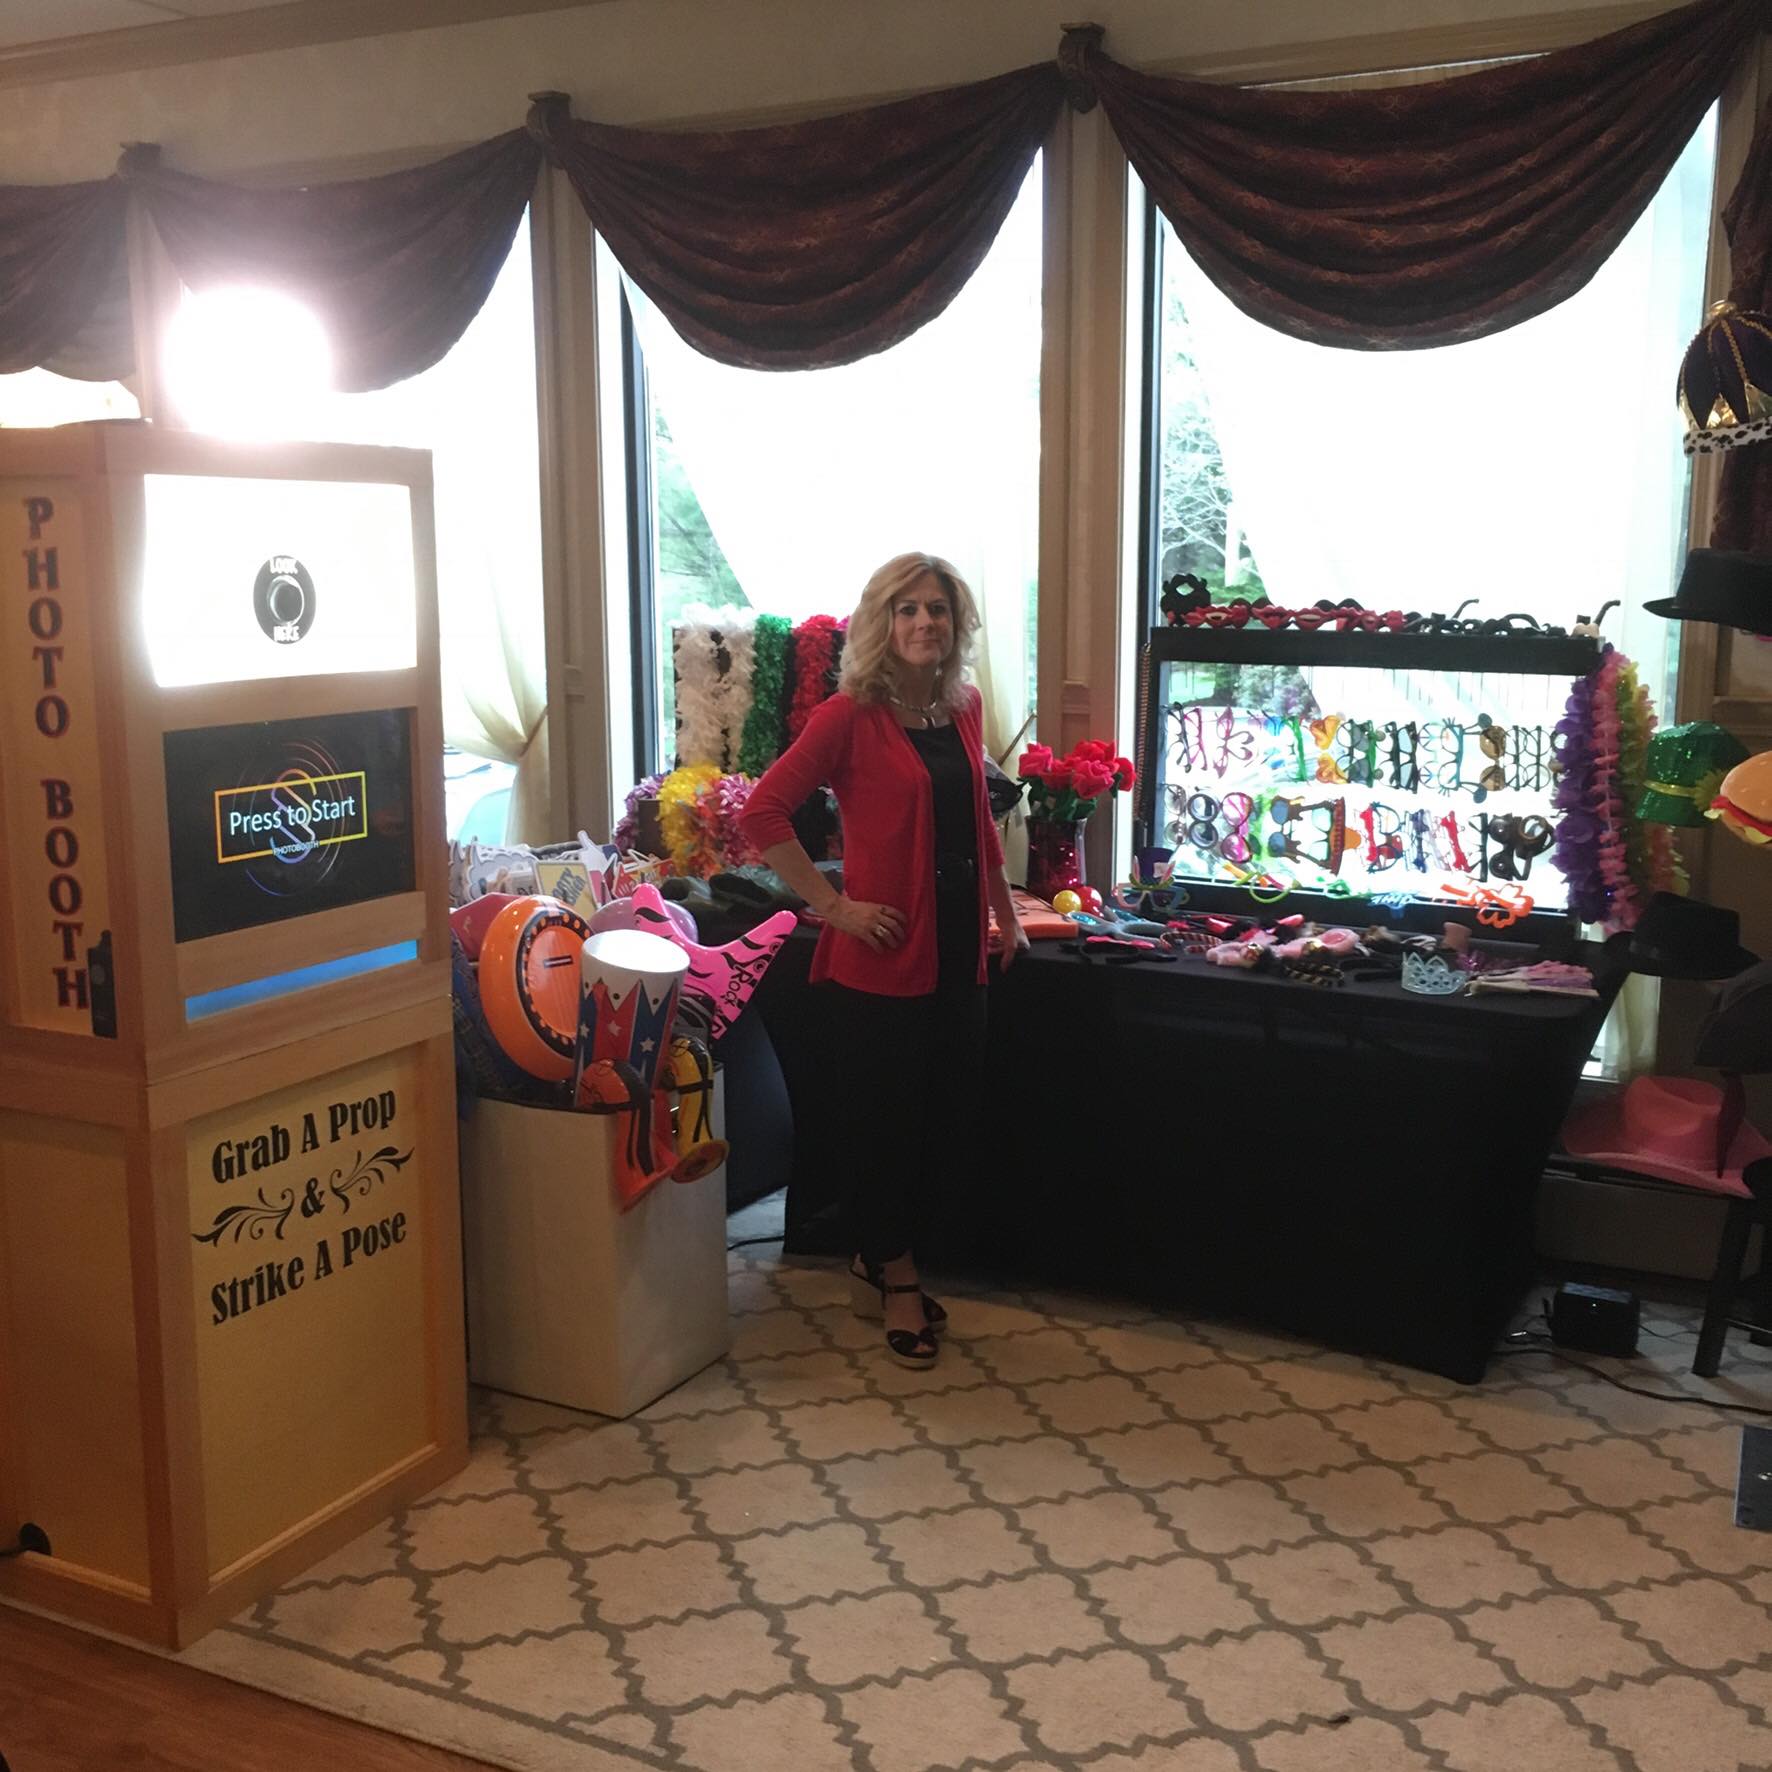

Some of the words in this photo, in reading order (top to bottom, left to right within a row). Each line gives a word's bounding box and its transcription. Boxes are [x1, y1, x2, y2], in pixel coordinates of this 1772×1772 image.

[22, 496, 70, 739] PHOTO
[230, 809, 282, 836] Press
[286, 804, 307, 826] to
[312, 796, 356, 822] Start
[273, 840, 320, 856] PHOTOBOOTH
[40, 778, 90, 1011] BOOTH
[212, 1124, 290, 1184] Grab
[302, 1113, 320, 1154] A
[328, 1090, 396, 1143] Prop
[301, 1177, 325, 1218] &
[210, 1256, 304, 1326] Strike
[314, 1240, 333, 1280] A
[342, 1212, 406, 1268] Pose
